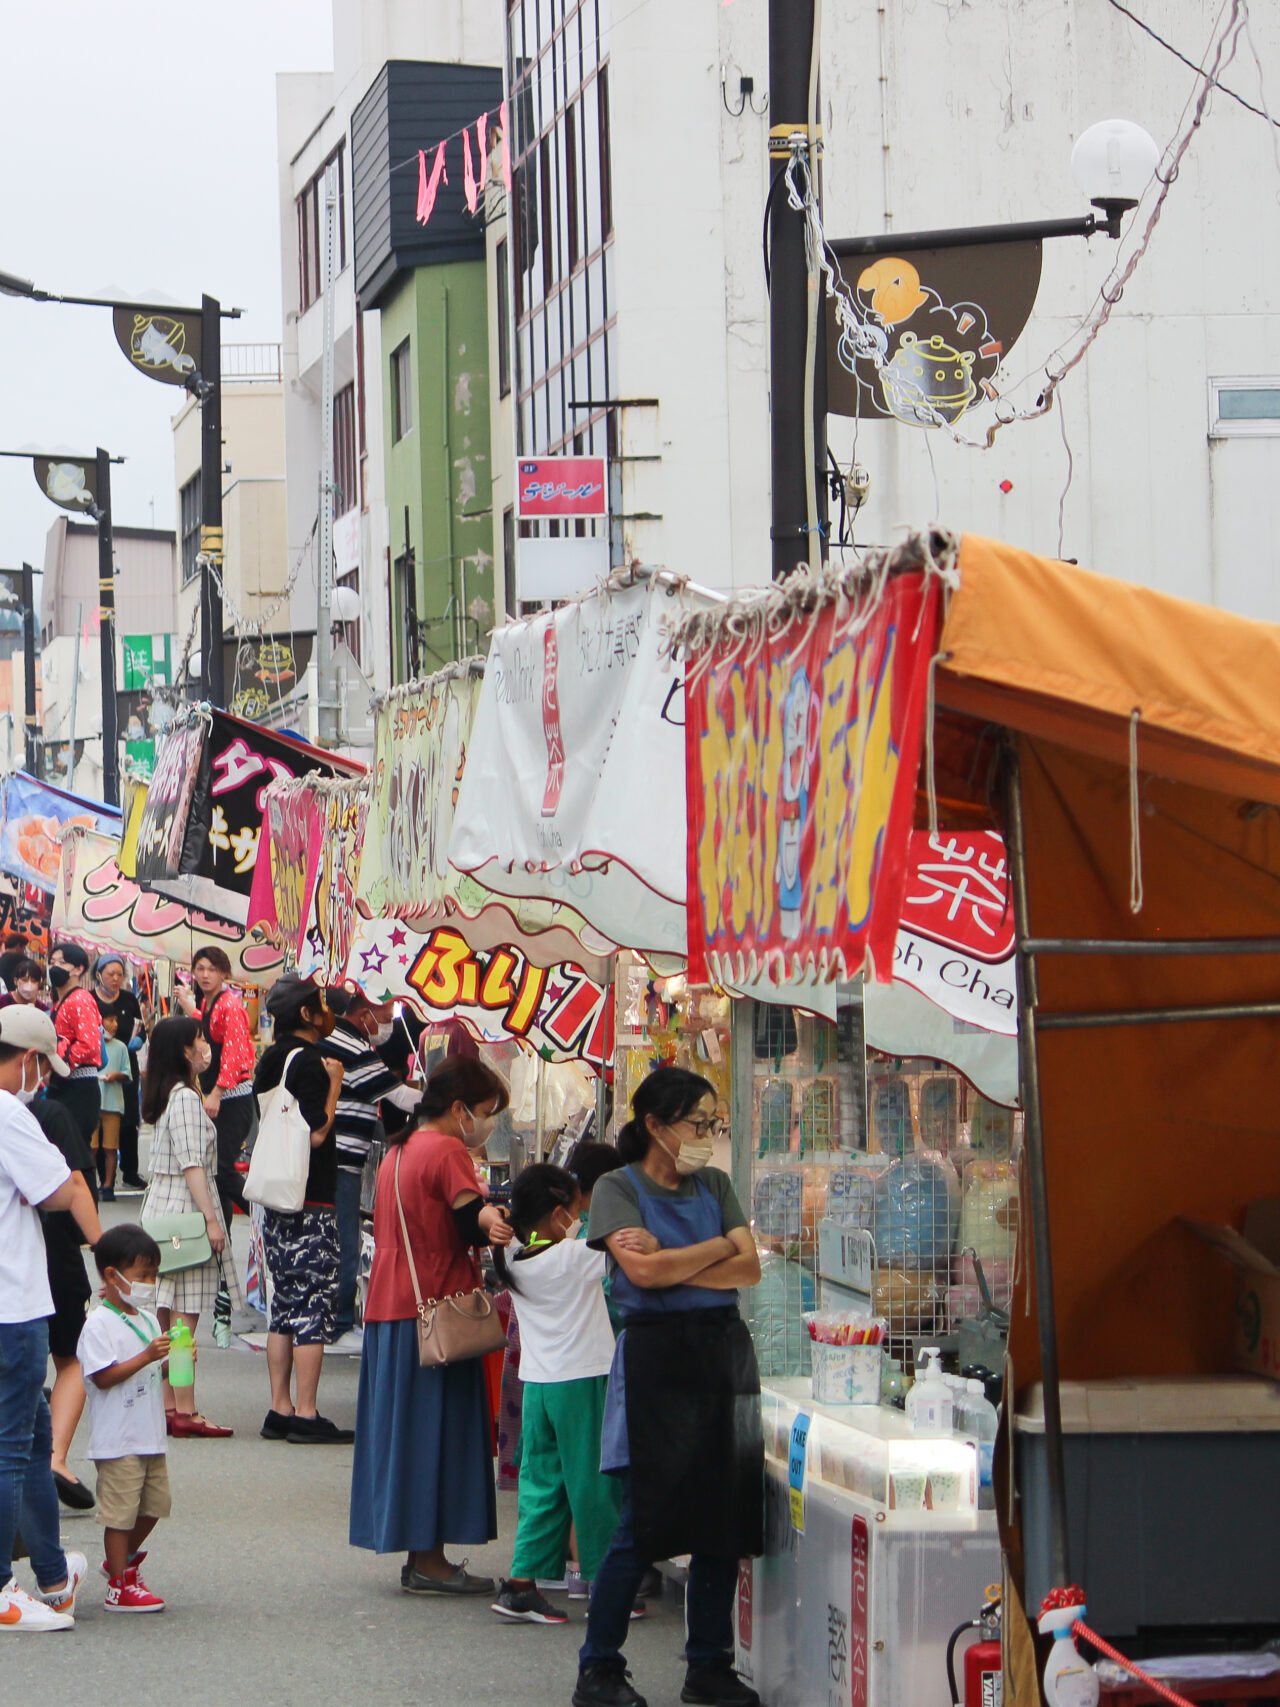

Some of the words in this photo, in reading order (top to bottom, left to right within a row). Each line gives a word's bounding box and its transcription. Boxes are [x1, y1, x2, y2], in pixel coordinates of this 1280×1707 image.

[939, 958, 1015, 1011] Cha
[792, 1427, 807, 1448] TAKE
[791, 1457, 802, 1476] OUT
